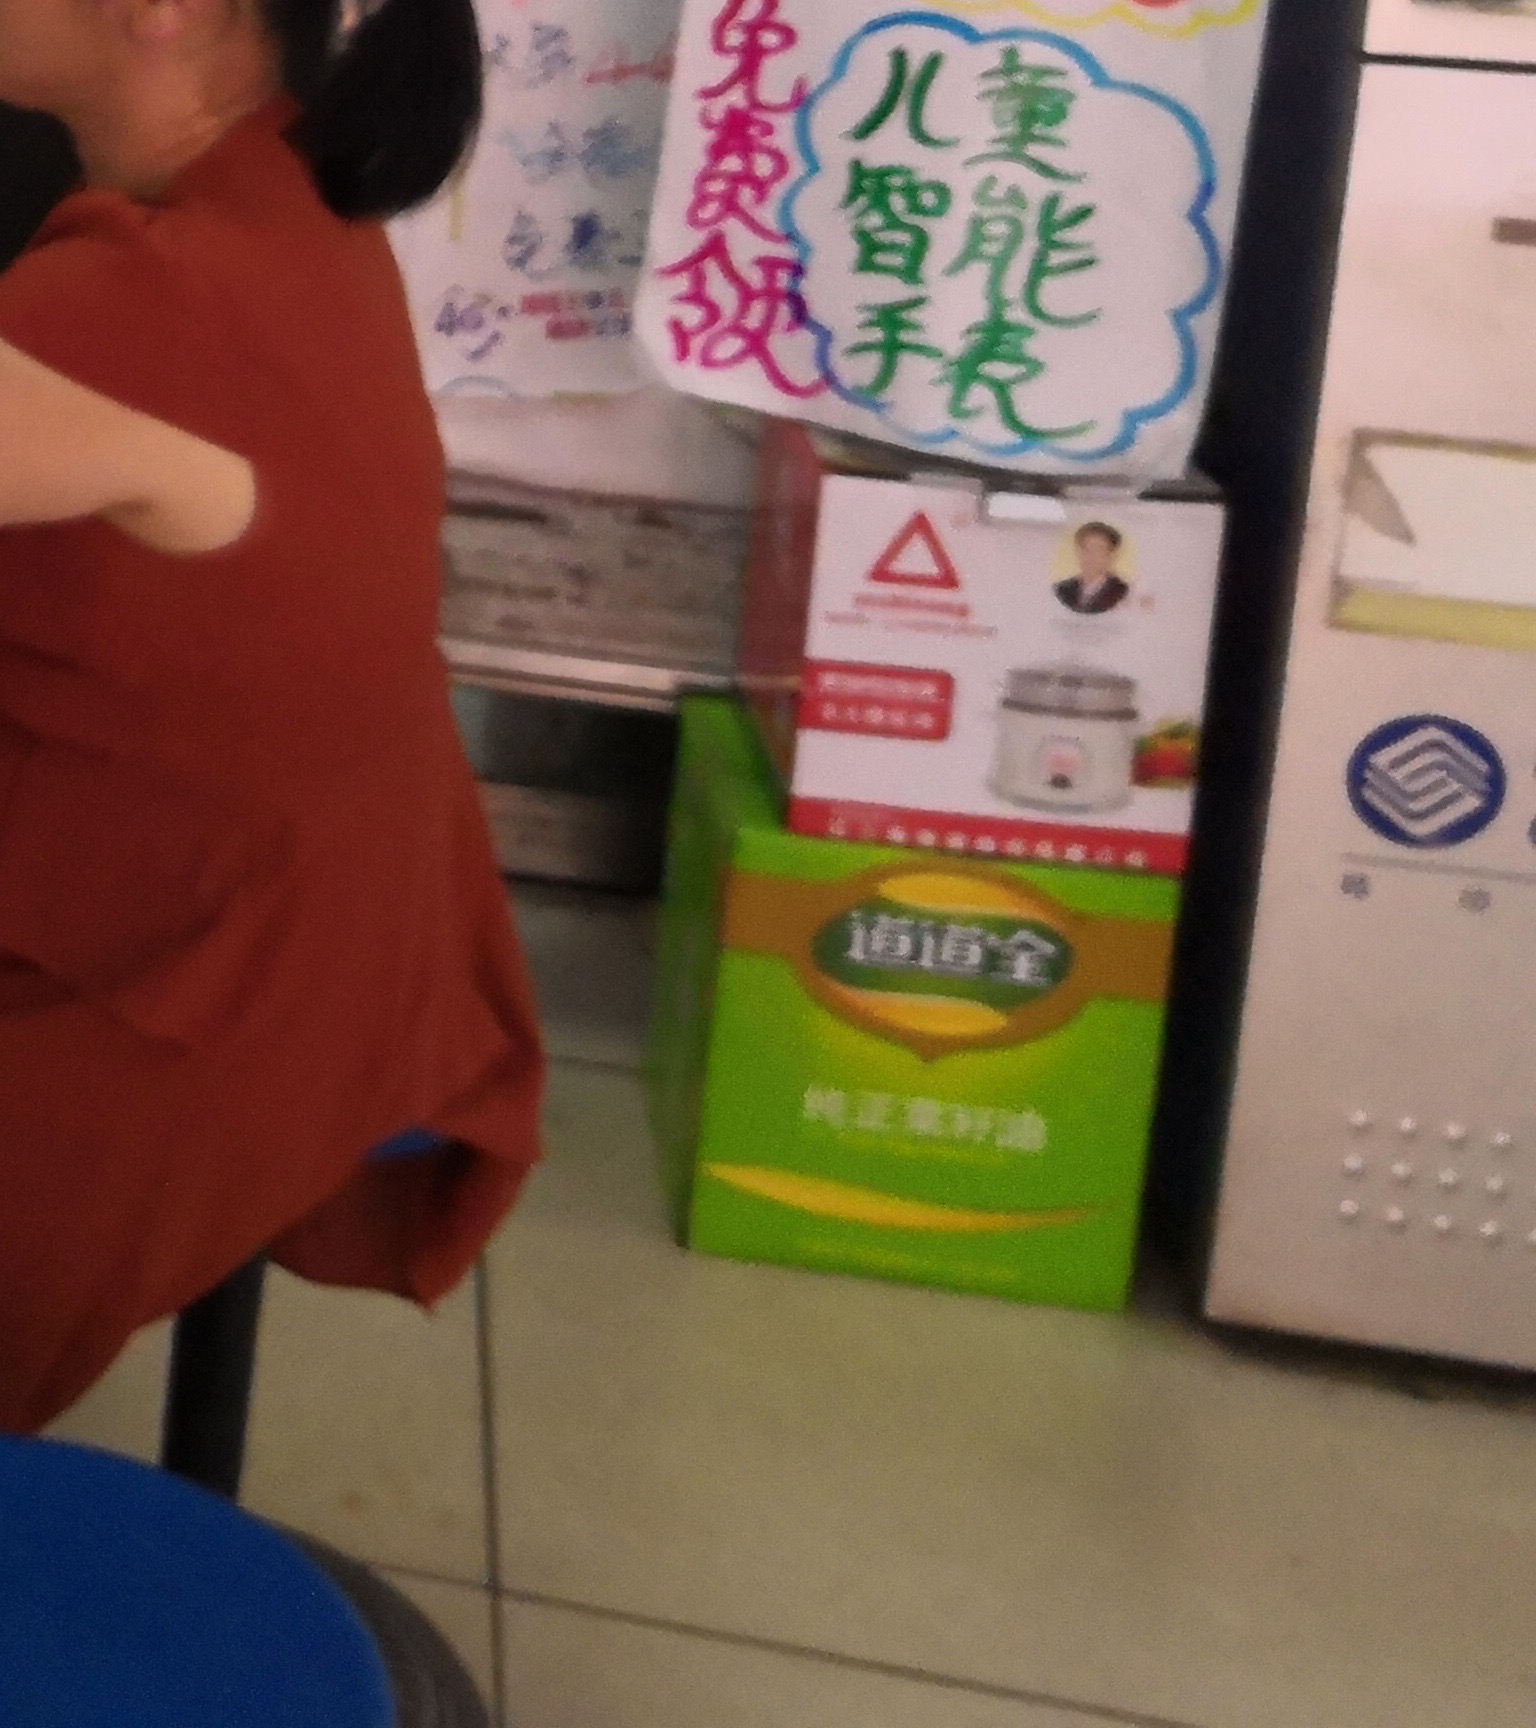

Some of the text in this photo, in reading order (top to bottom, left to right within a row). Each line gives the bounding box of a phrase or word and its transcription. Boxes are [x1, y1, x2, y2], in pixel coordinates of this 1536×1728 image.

[839, 44, 1088, 185] 儿童
[837, 158, 1105, 328] 智能
[842, 294, 1098, 440] 手表
[847, 910, 1057, 988] 道道全
